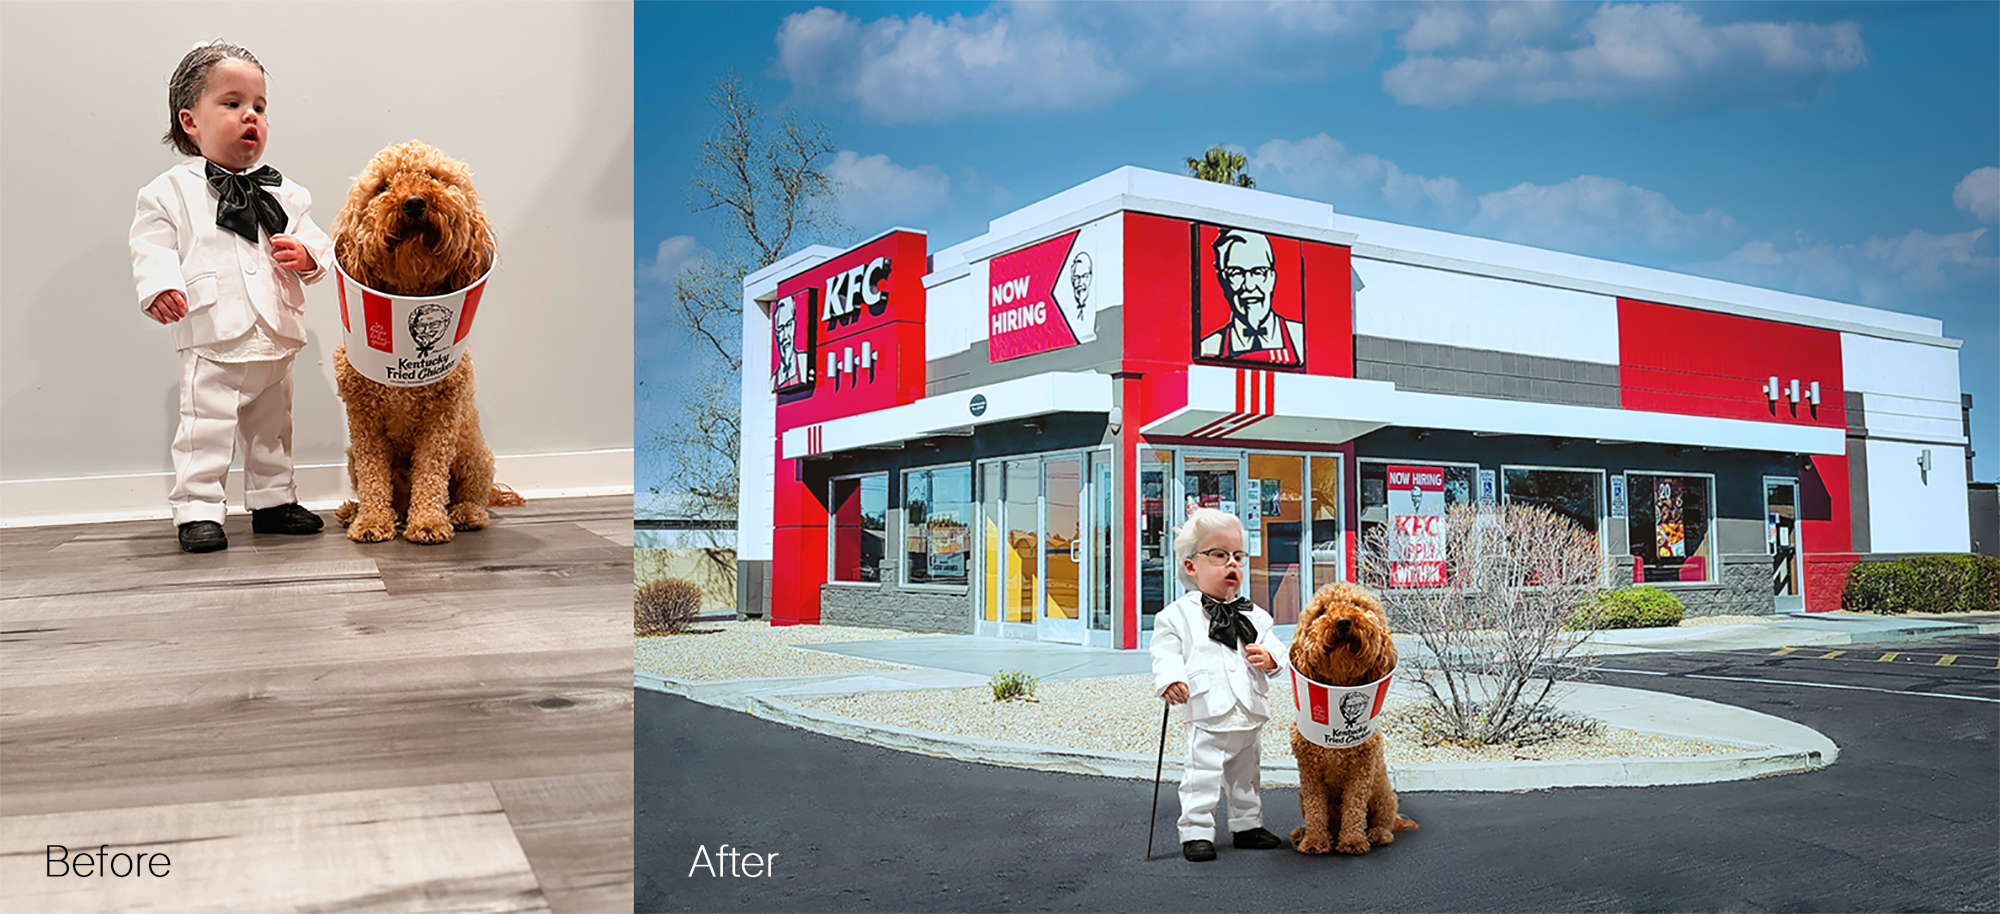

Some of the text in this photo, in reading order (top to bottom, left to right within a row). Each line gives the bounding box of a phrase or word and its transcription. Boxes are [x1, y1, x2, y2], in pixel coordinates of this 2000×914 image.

[821, 257, 886, 321] KFC
[992, 275, 1030, 307] NOW
[992, 301, 1046, 336] HIRING
[386, 366, 415, 379] Fried
[398, 353, 450, 370] Kentucky
[1389, 471, 1442, 486] NOW HIRING
[1394, 515, 1439, 537] KFC
